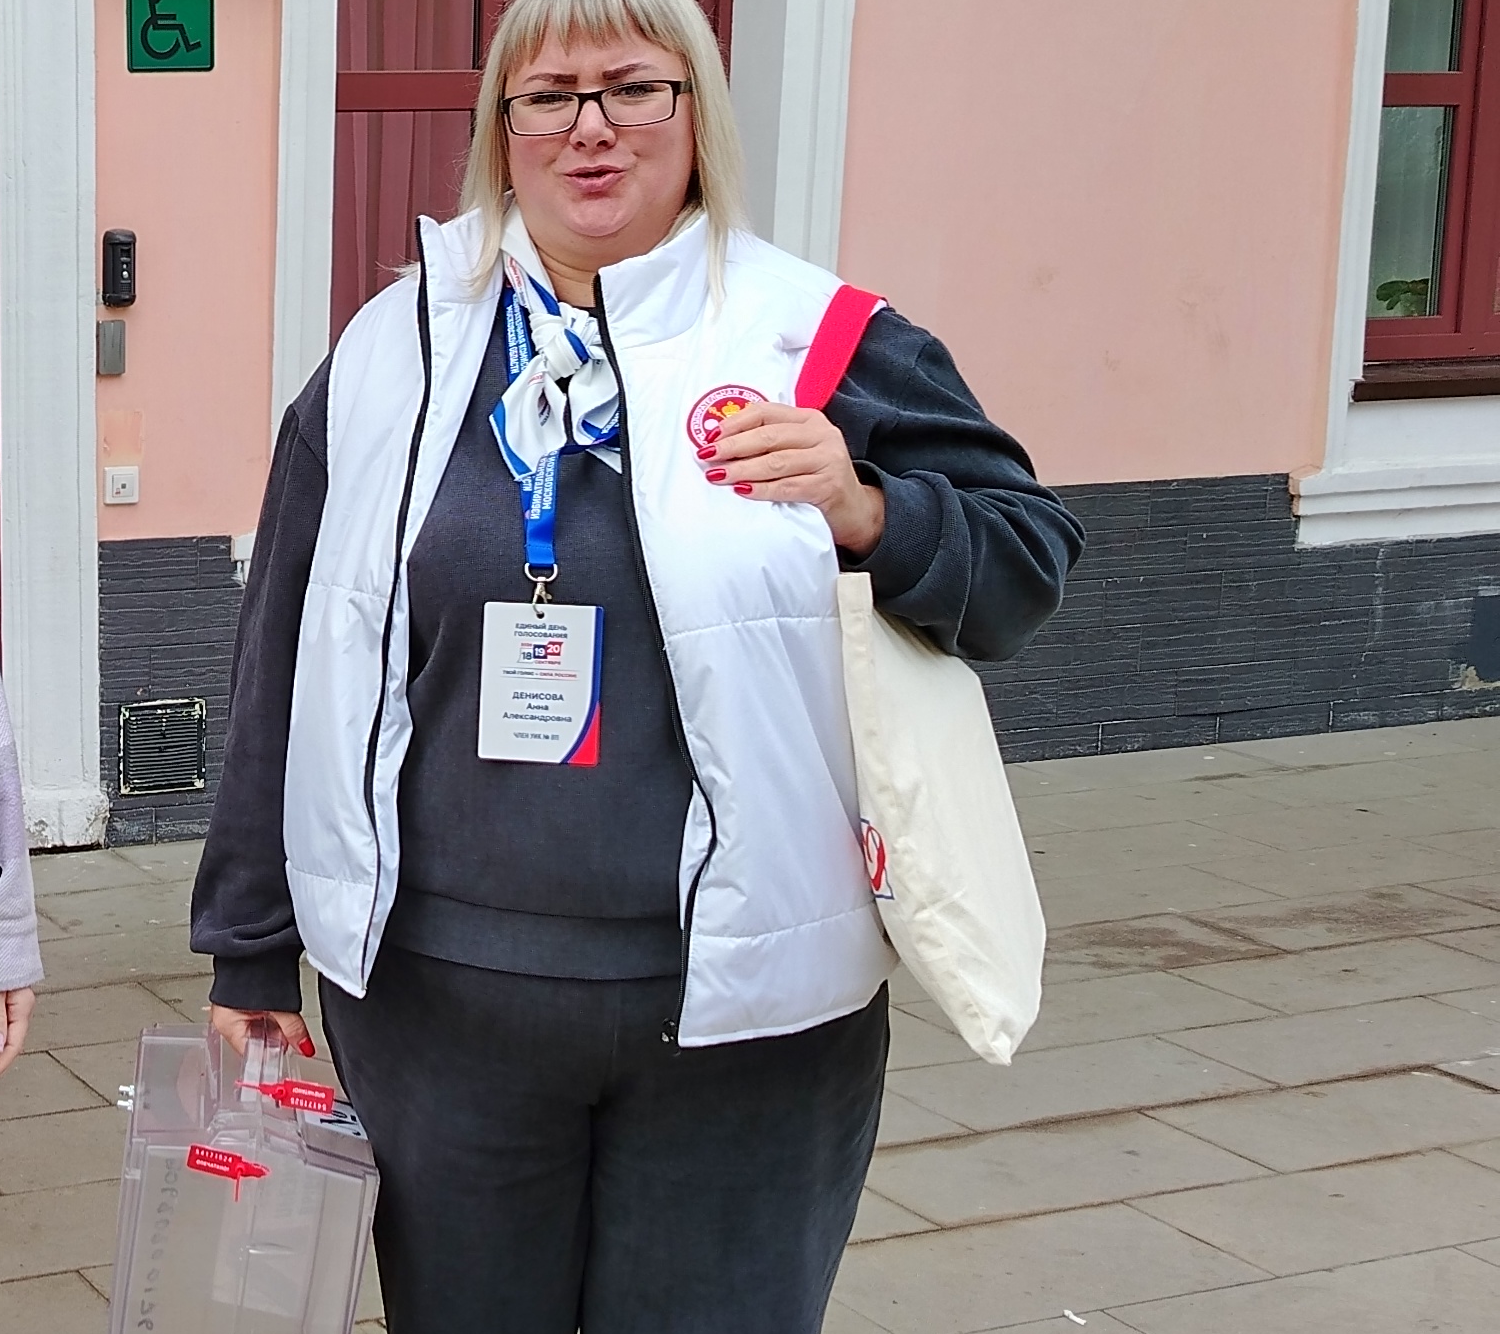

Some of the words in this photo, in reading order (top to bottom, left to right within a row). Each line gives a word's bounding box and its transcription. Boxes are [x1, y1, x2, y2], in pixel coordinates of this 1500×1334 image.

[521, 651, 532, 660] 18
[534, 648, 545, 656] 19
[546, 644, 560, 653] 20
[512, 691, 564, 701] ДЕНИСОВА
[503, 712, 572, 722] Александровна
